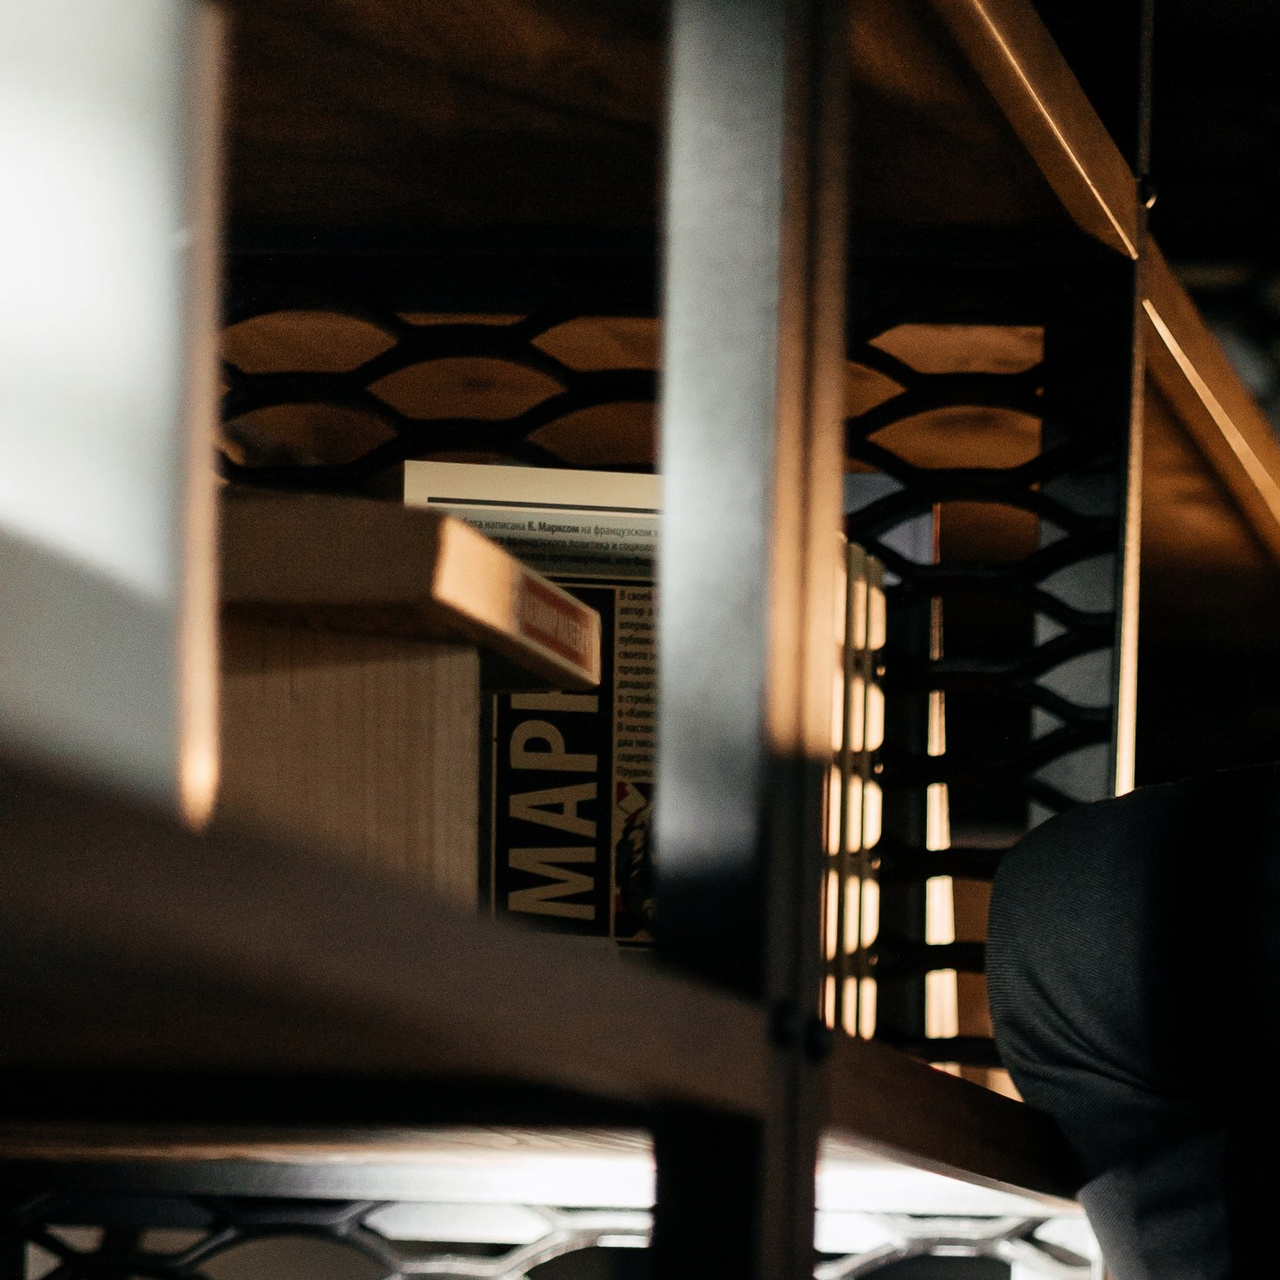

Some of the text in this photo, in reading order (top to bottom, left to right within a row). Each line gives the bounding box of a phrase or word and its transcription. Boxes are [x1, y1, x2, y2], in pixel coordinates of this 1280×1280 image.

[484, 520, 526, 532] написана
[528, 521, 537, 531] К.
[538, 521, 580, 535] Марксом
[581, 526, 592, 534] на
[593, 524, 652, 538] французском
